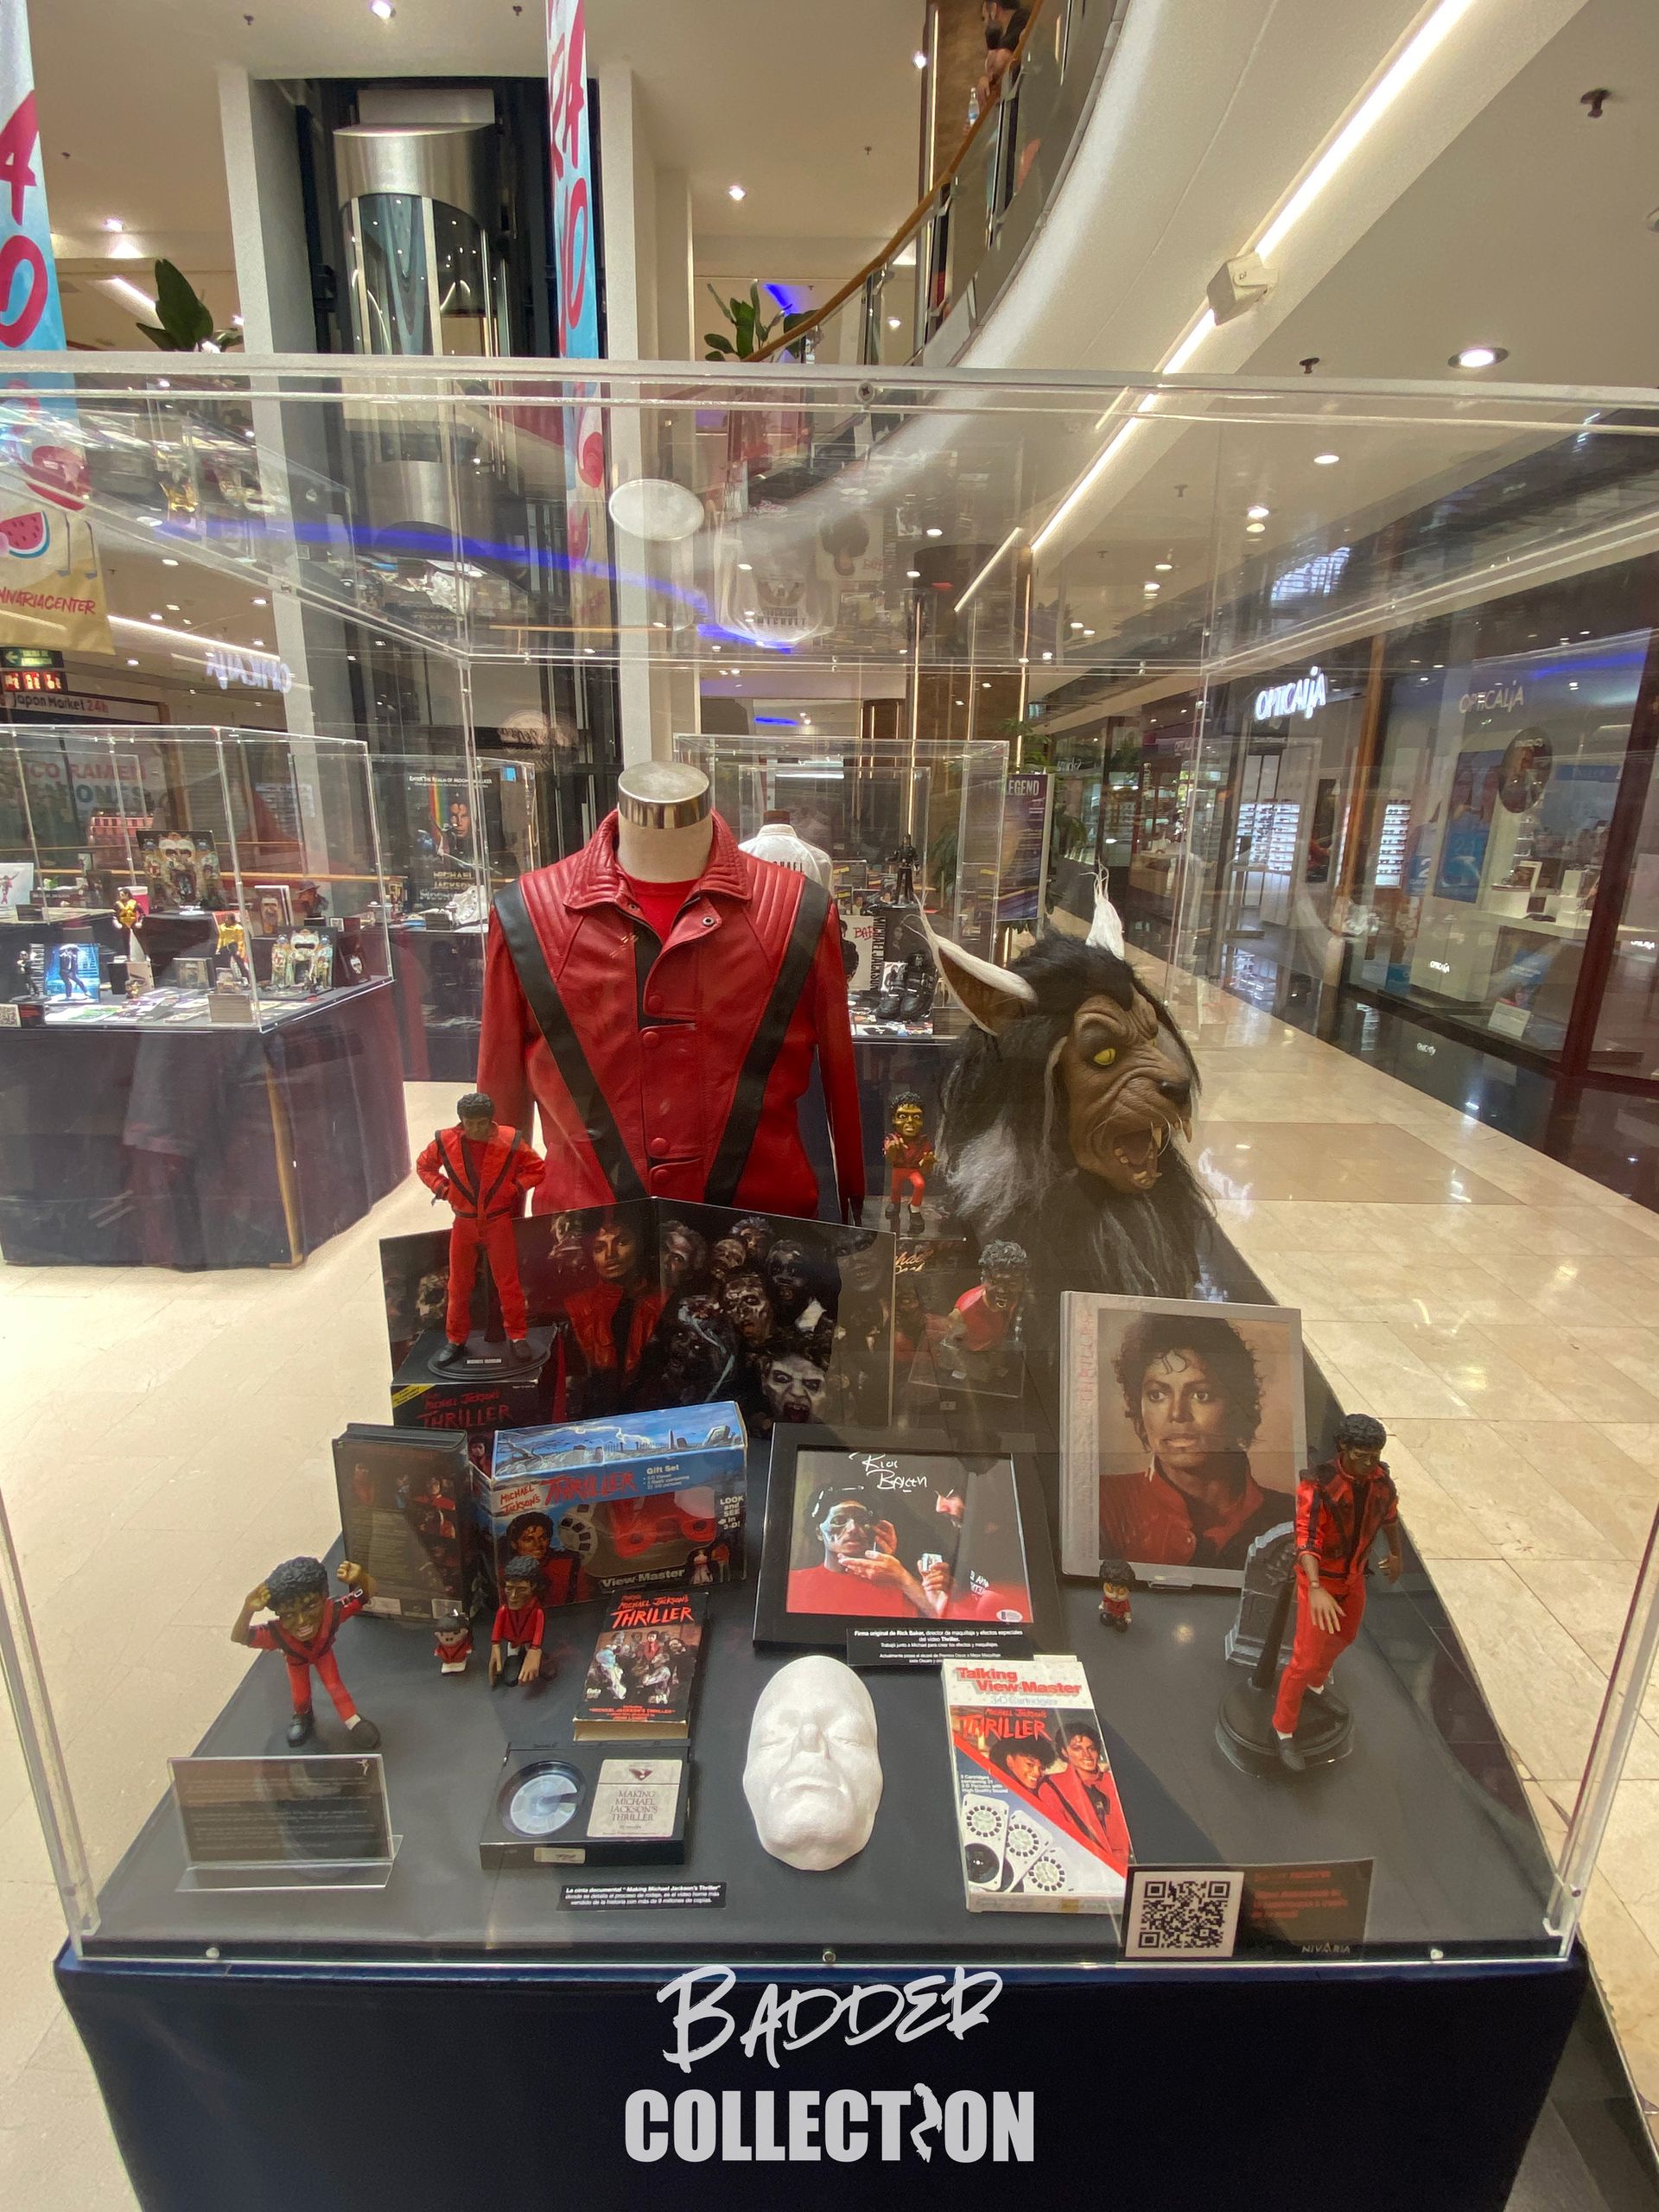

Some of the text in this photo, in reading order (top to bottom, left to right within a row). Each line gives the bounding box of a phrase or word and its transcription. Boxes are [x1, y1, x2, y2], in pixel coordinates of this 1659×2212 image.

[13, 692, 47, 709] Japan
[48, 696, 85, 710] Market
[417, 1404, 512, 1428] THRILLER
[646, 1464, 679, 1475] Gift Set
[500, 1484, 535, 1505] MICHAEL
[539, 1471, 638, 1506] THRILLER
[720, 1495, 744, 1505] LOOK
[601, 1568, 685, 1588] View-Master
[609, 1606, 695, 1630] THRILLER
[956, 1667, 1018, 1681] Talking
[974, 1680, 1082, 1697] View-Master
[957, 1713, 1052, 1742] THRILLER
[610, 1805, 658, 1814] JACKSON'S
[1301, 1942, 1351, 1954] NIVARIA
[657, 1965, 1003, 2074] BADDER
